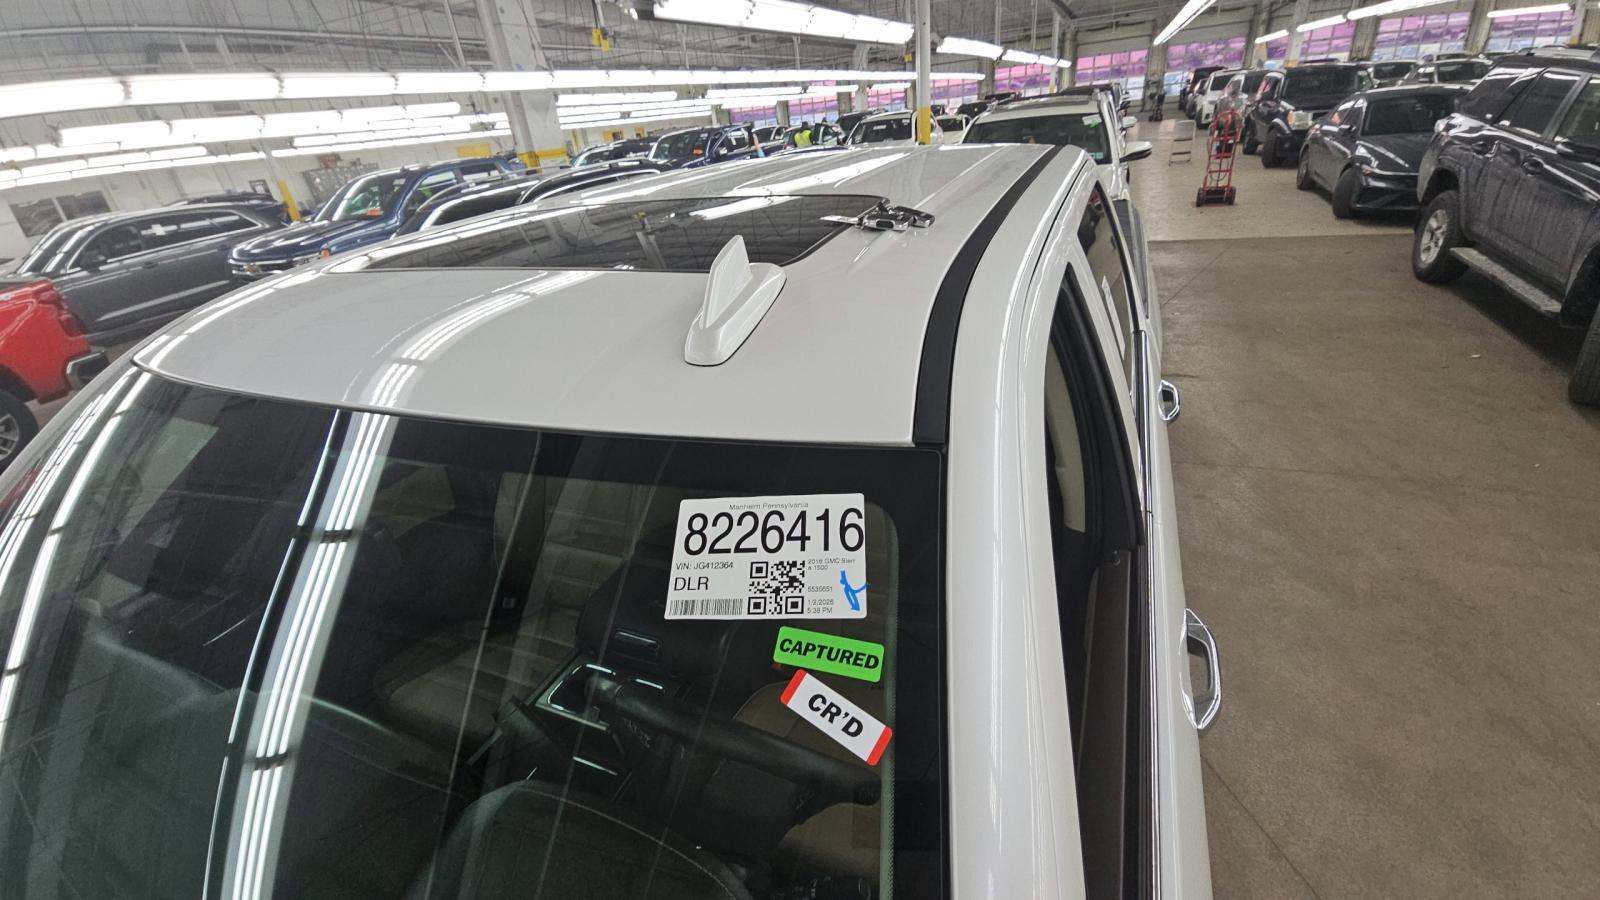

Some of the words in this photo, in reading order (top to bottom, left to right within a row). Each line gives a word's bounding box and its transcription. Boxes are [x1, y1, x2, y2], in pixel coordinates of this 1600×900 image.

[684, 508, 864, 555] 8226416
[673, 576, 708, 590] DLR
[780, 638, 879, 669] CAPTURED
[808, 693, 863, 737] CR'D
